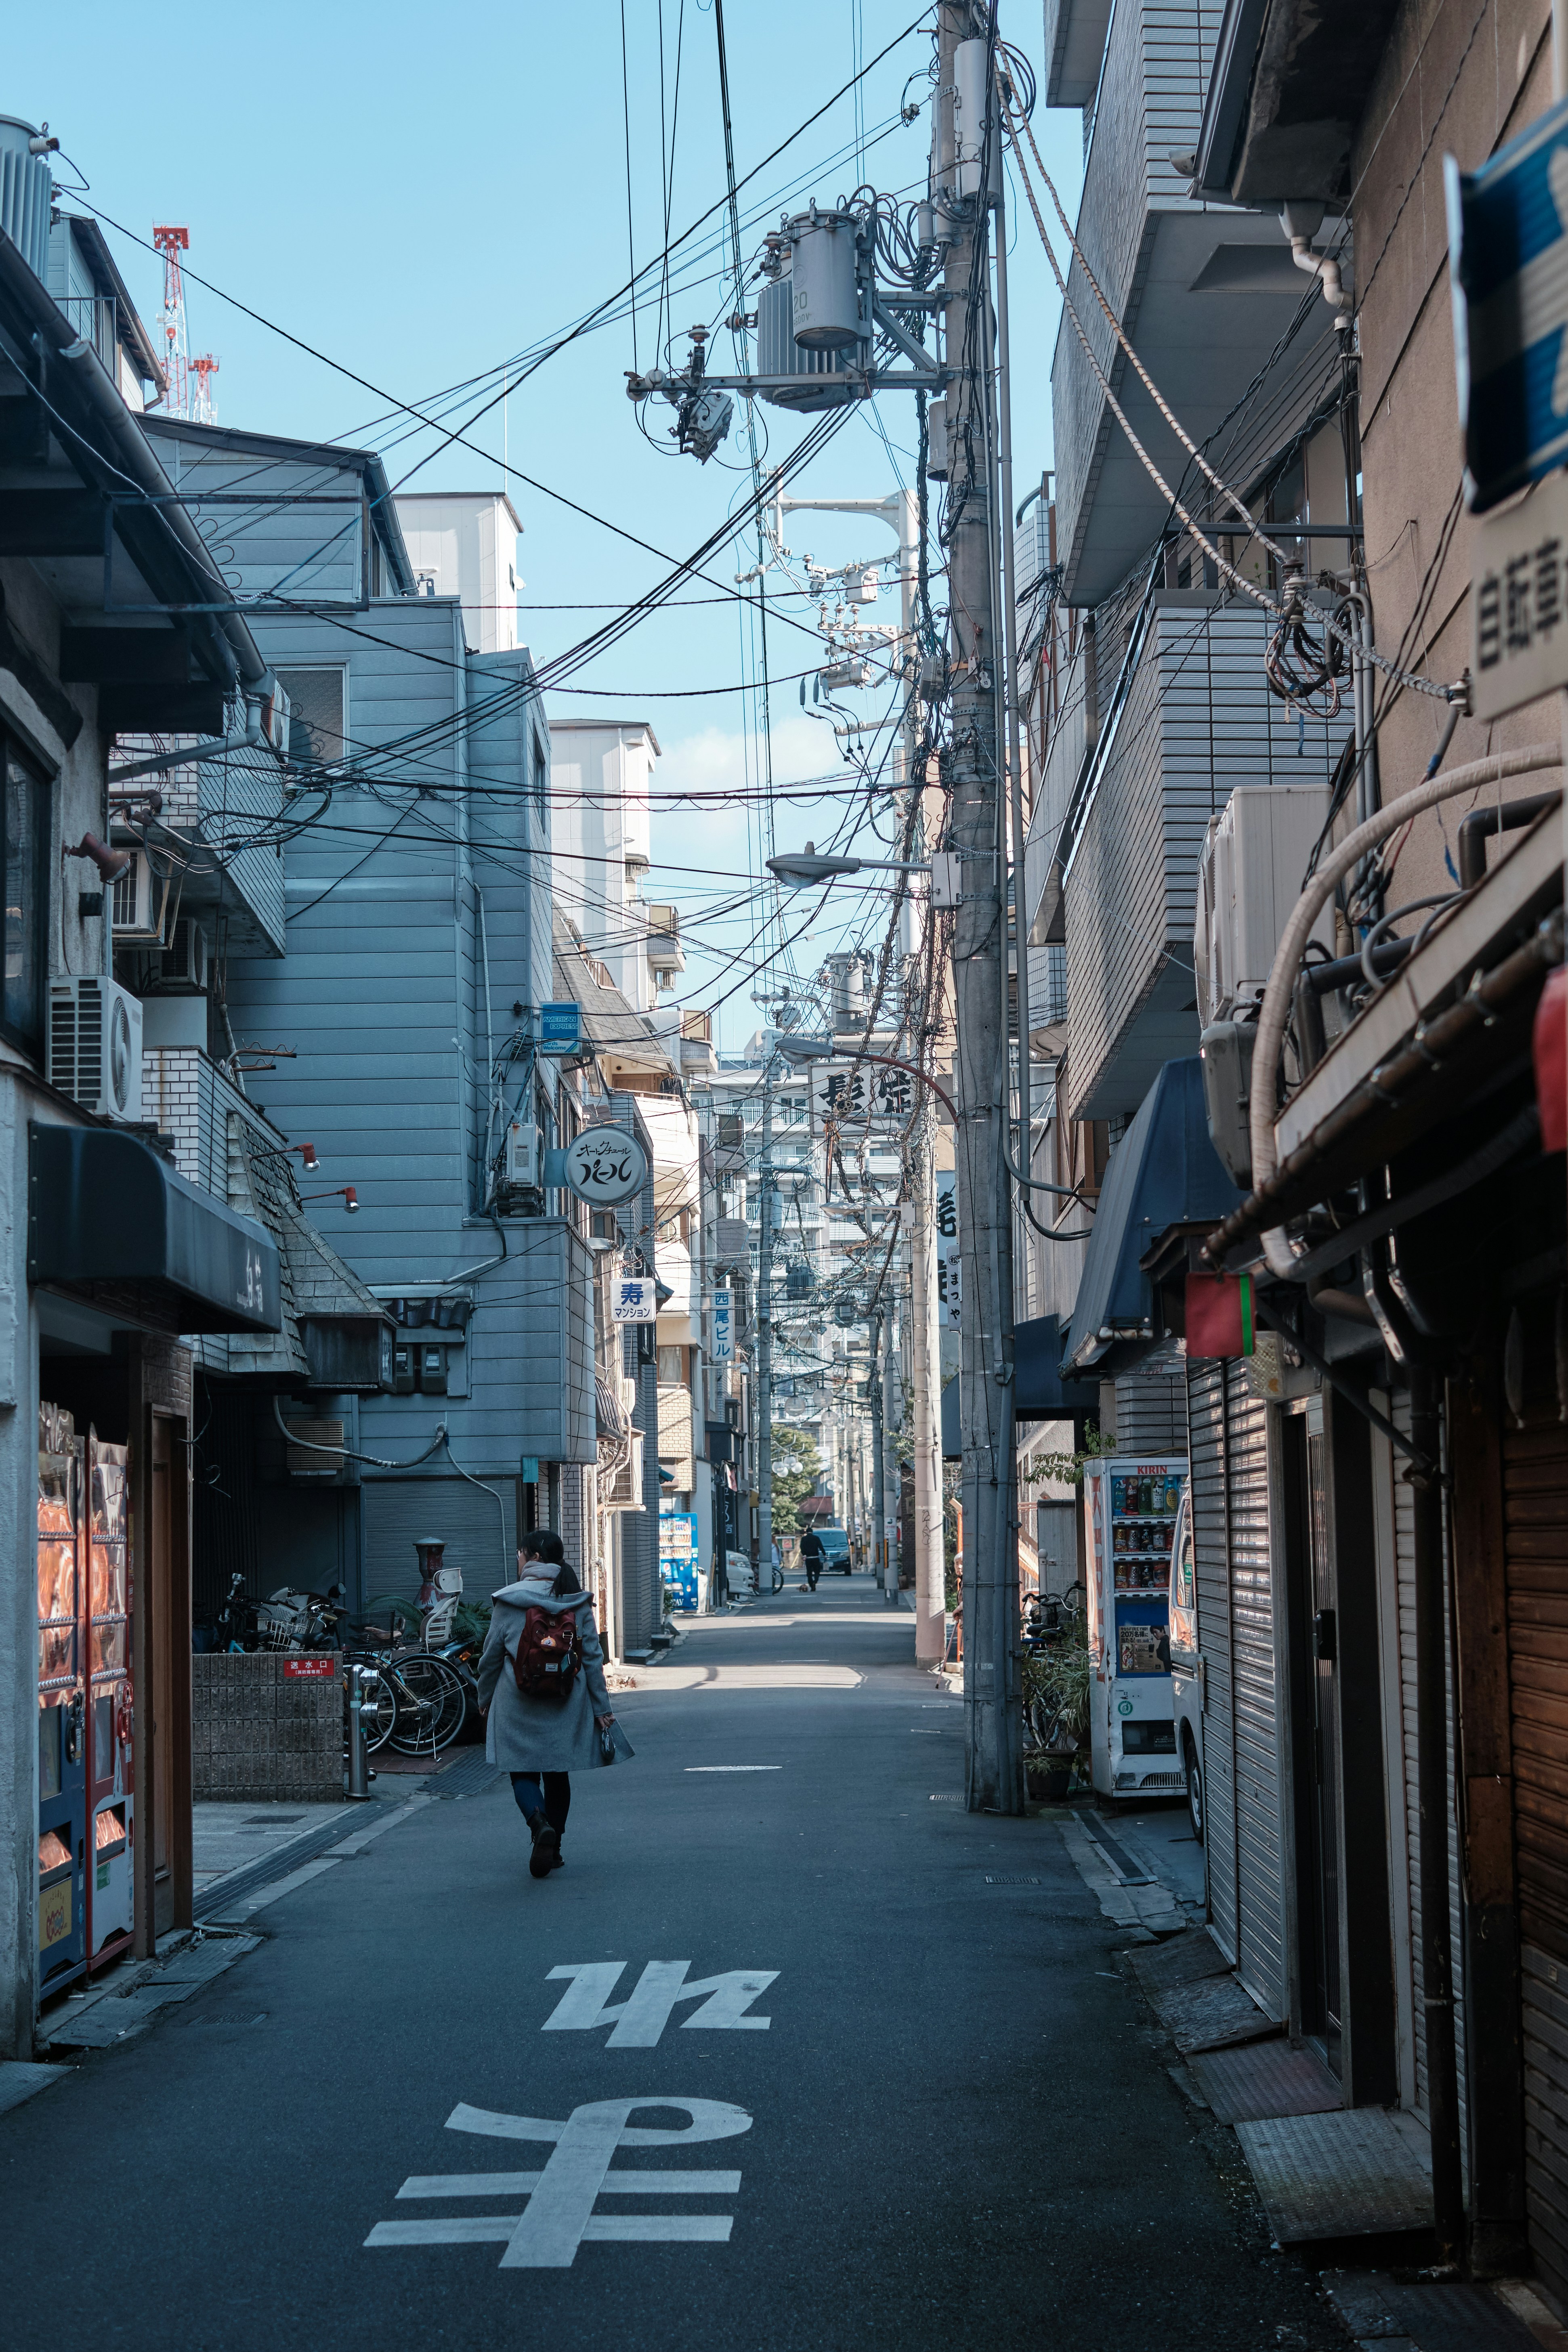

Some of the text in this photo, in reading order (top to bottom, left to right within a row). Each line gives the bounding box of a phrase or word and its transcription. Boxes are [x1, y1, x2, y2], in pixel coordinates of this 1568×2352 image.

[793, 291, 807, 314] 20
[1478, 535, 1568, 670] 自転車
[576, 1141, 631, 1157] オートクチュール
[579, 1156, 632, 1186] パール
[621, 1282, 644, 1305] 寿
[951, 1272, 960, 1320] まつや
[615, 1308, 650, 1318] マンション
[715, 1292, 730, 1356] 西尾ビル
[1137, 1465, 1167, 1474] KIRIN
[290, 1661, 327, 1669] 送水口
